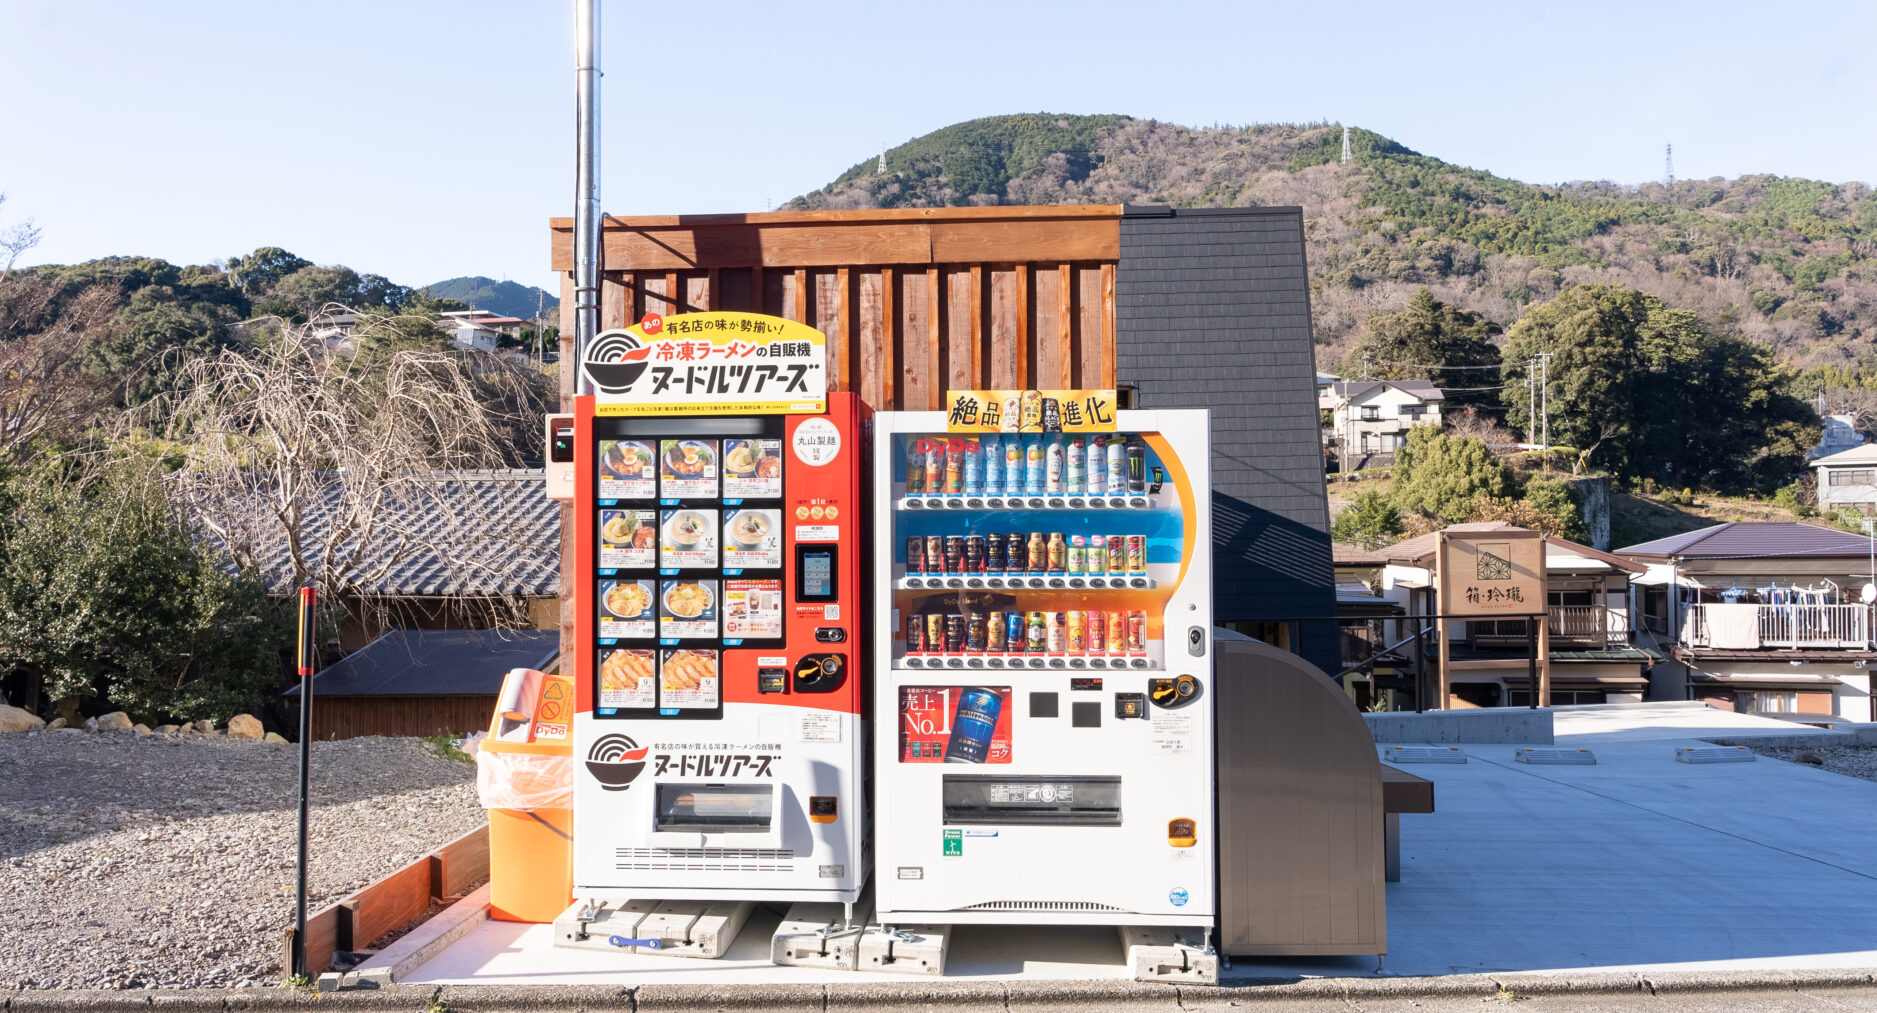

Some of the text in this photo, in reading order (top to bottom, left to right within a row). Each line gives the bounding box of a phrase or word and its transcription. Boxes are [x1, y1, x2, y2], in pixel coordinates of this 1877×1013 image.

[643, 318, 660, 330] あの
[655, 341, 811, 362] 冷凍ラーメンの自販機
[651, 364, 820, 394] ヌードルツアーズ
[949, 396, 1113, 426] 絶品 進化
[797, 436, 836, 445] 丸山製麺
[917, 439, 979, 457] DyDo
[902, 694, 936, 711] 売上
[535, 726, 565, 735] DyDo
[654, 755, 782, 777] ヌードルツアーズ
